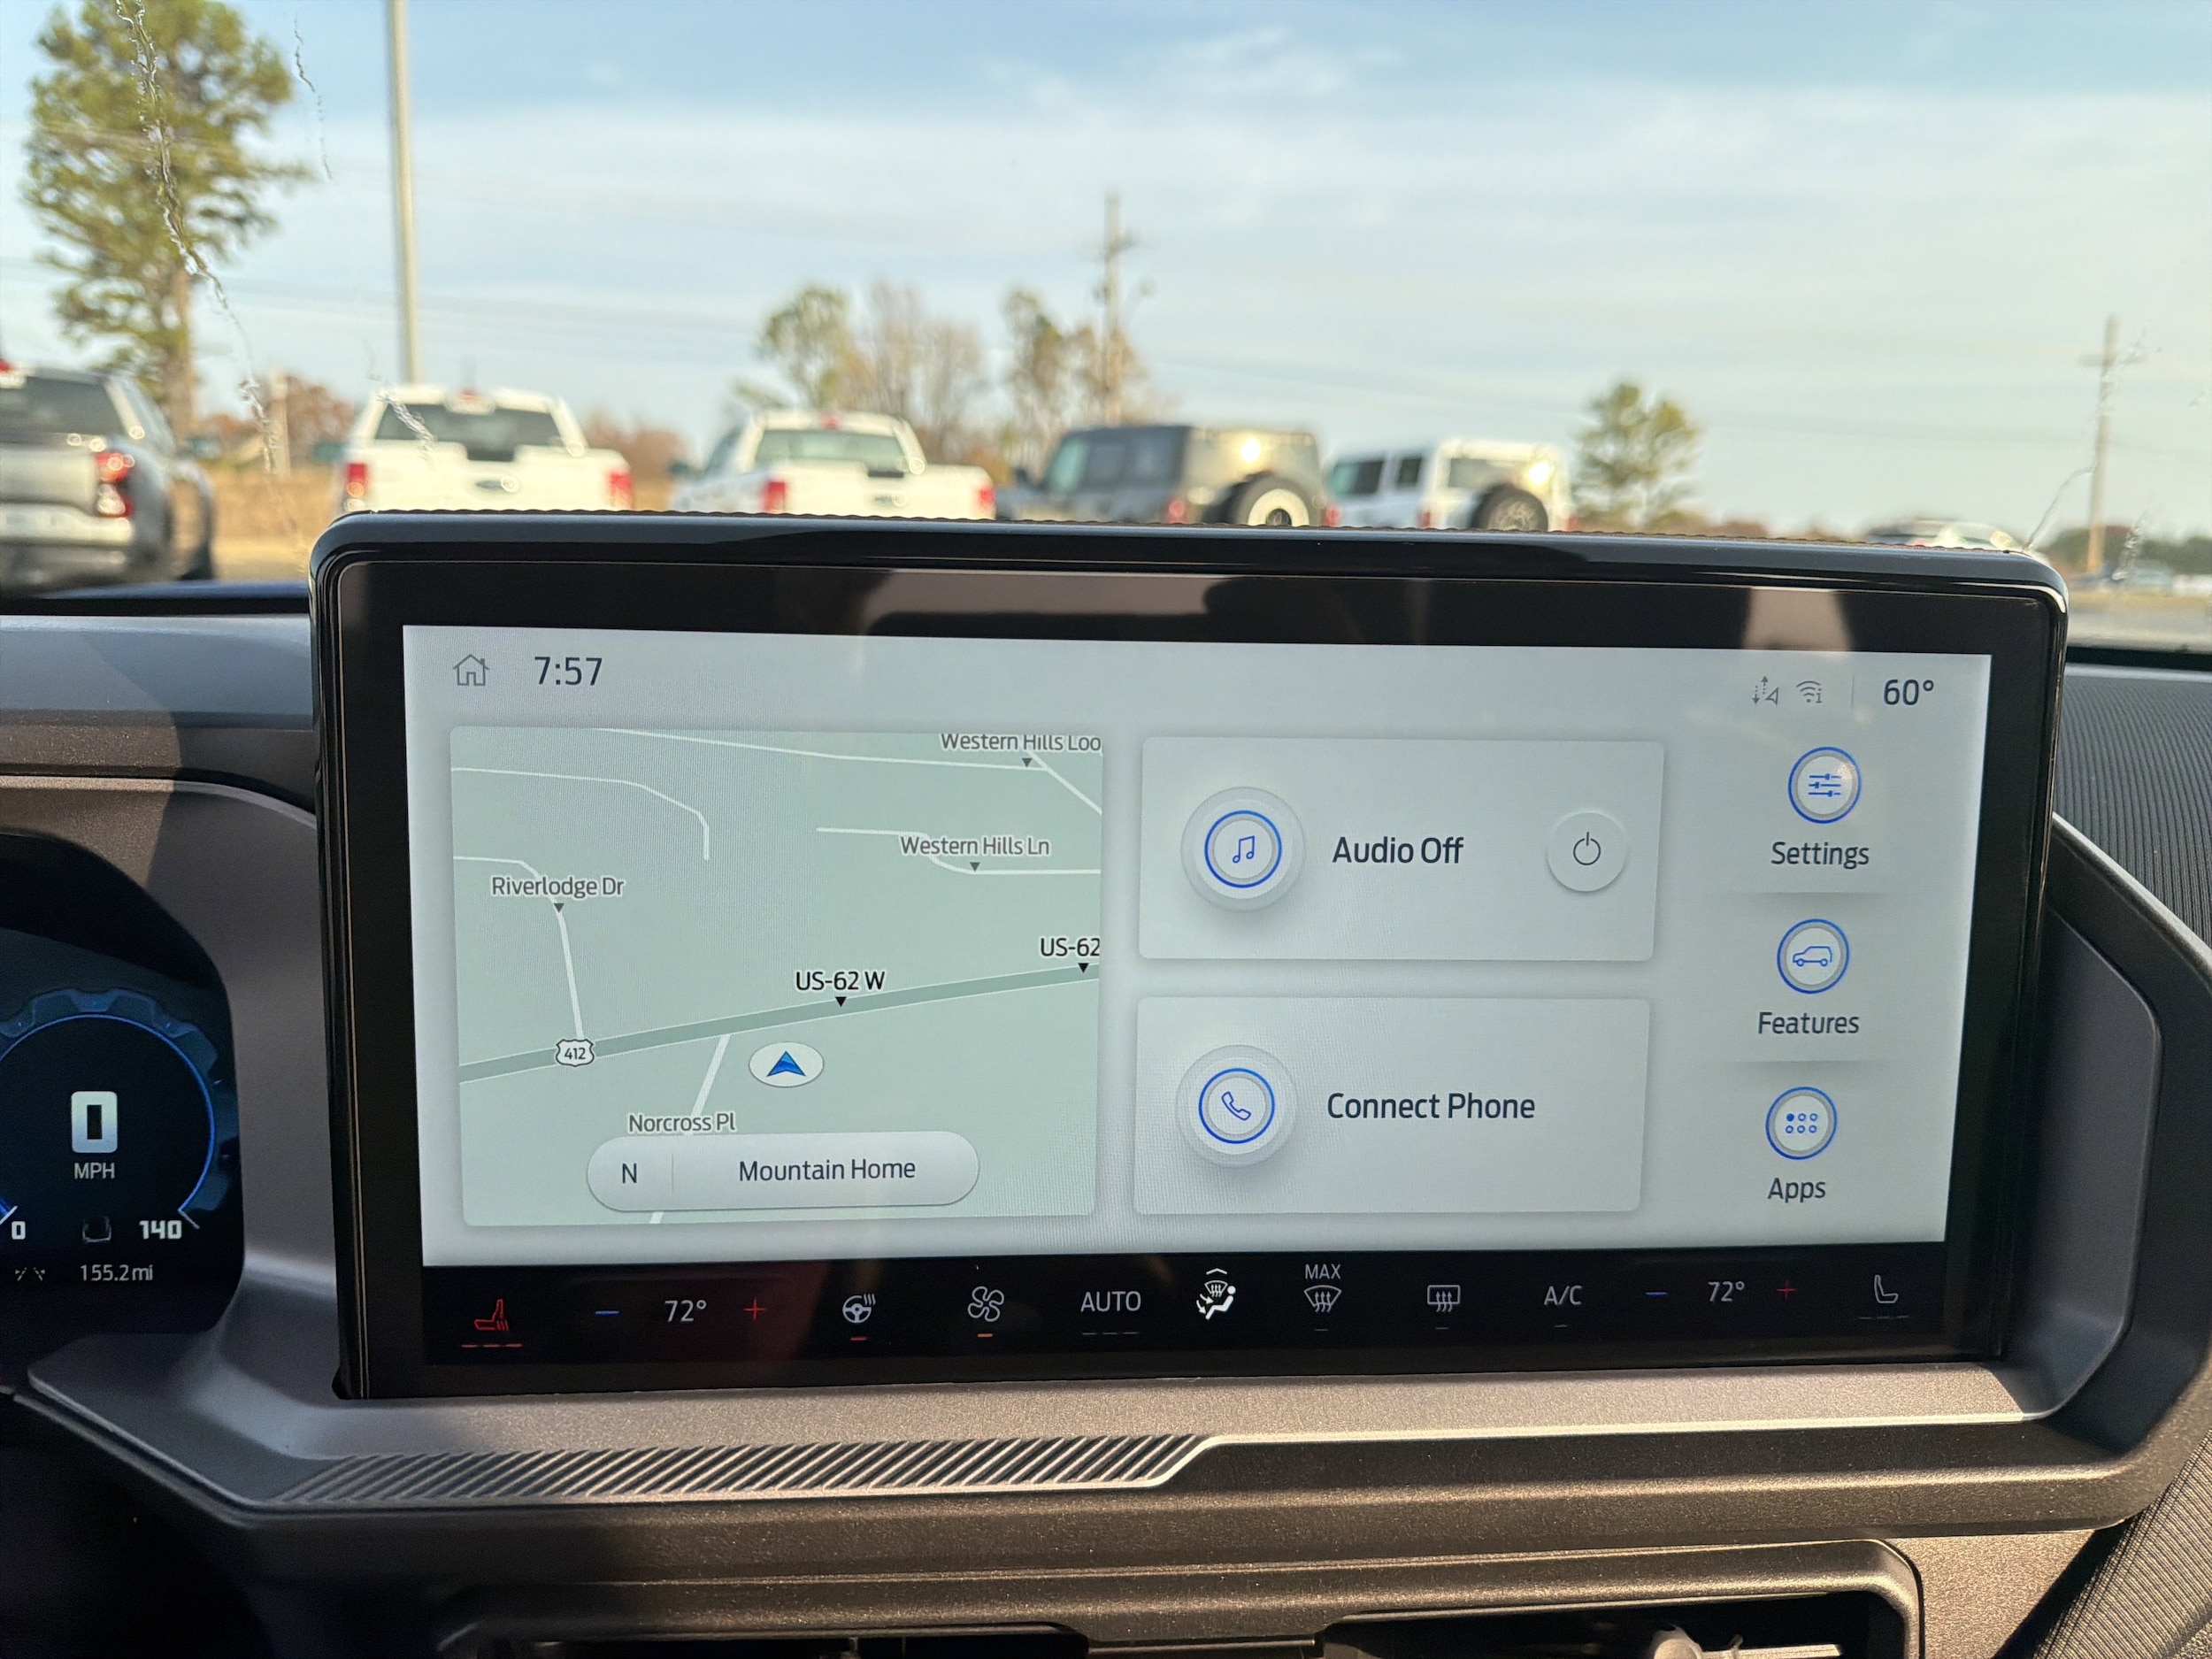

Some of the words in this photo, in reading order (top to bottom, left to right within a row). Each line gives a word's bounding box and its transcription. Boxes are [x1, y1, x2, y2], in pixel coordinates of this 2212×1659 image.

[534, 656, 603, 687] 7:57
[1883, 678, 1935, 707] 60°
[941, 733, 1019, 751] Western
[1023, 733, 1064, 751] Hills
[901, 835, 979, 856] Western
[983, 836, 1024, 856] Hills
[1028, 837, 1049, 856] Ln
[1333, 837, 1413, 864] Audio
[1420, 835, 1464, 864] Off
[1770, 841, 1870, 870] Settings
[491, 877, 598, 898] Riverlodge
[602, 877, 624, 896] Dr
[1040, 938, 1101, 958] US-62
[795, 971, 859, 991] US-62
[861, 971, 885, 990] W
[1758, 1012, 1860, 1033] Features
[563, 1047, 587, 1062] 412
[1327, 1093, 1440, 1120] Connect
[1447, 1092, 1536, 1119] Phone
[628, 1113, 710, 1133] Norcross
[715, 1112, 735, 1131] Pl
[73, 1163, 115, 1179] MPH
[621, 1163, 638, 1183] N
[738, 1159, 845, 1182] Mountain
[850, 1157, 916, 1180] Home
[1768, 1177, 1827, 1203] Apps
[139, 1220, 182, 1240] 140
[1304, 1264, 1341, 1280] MAX
[1080, 1291, 1141, 1313] AUTO
[1543, 1285, 1582, 1306] A/C
[1708, 1281, 1746, 1302] 72°
[664, 1300, 707, 1324] 72°
